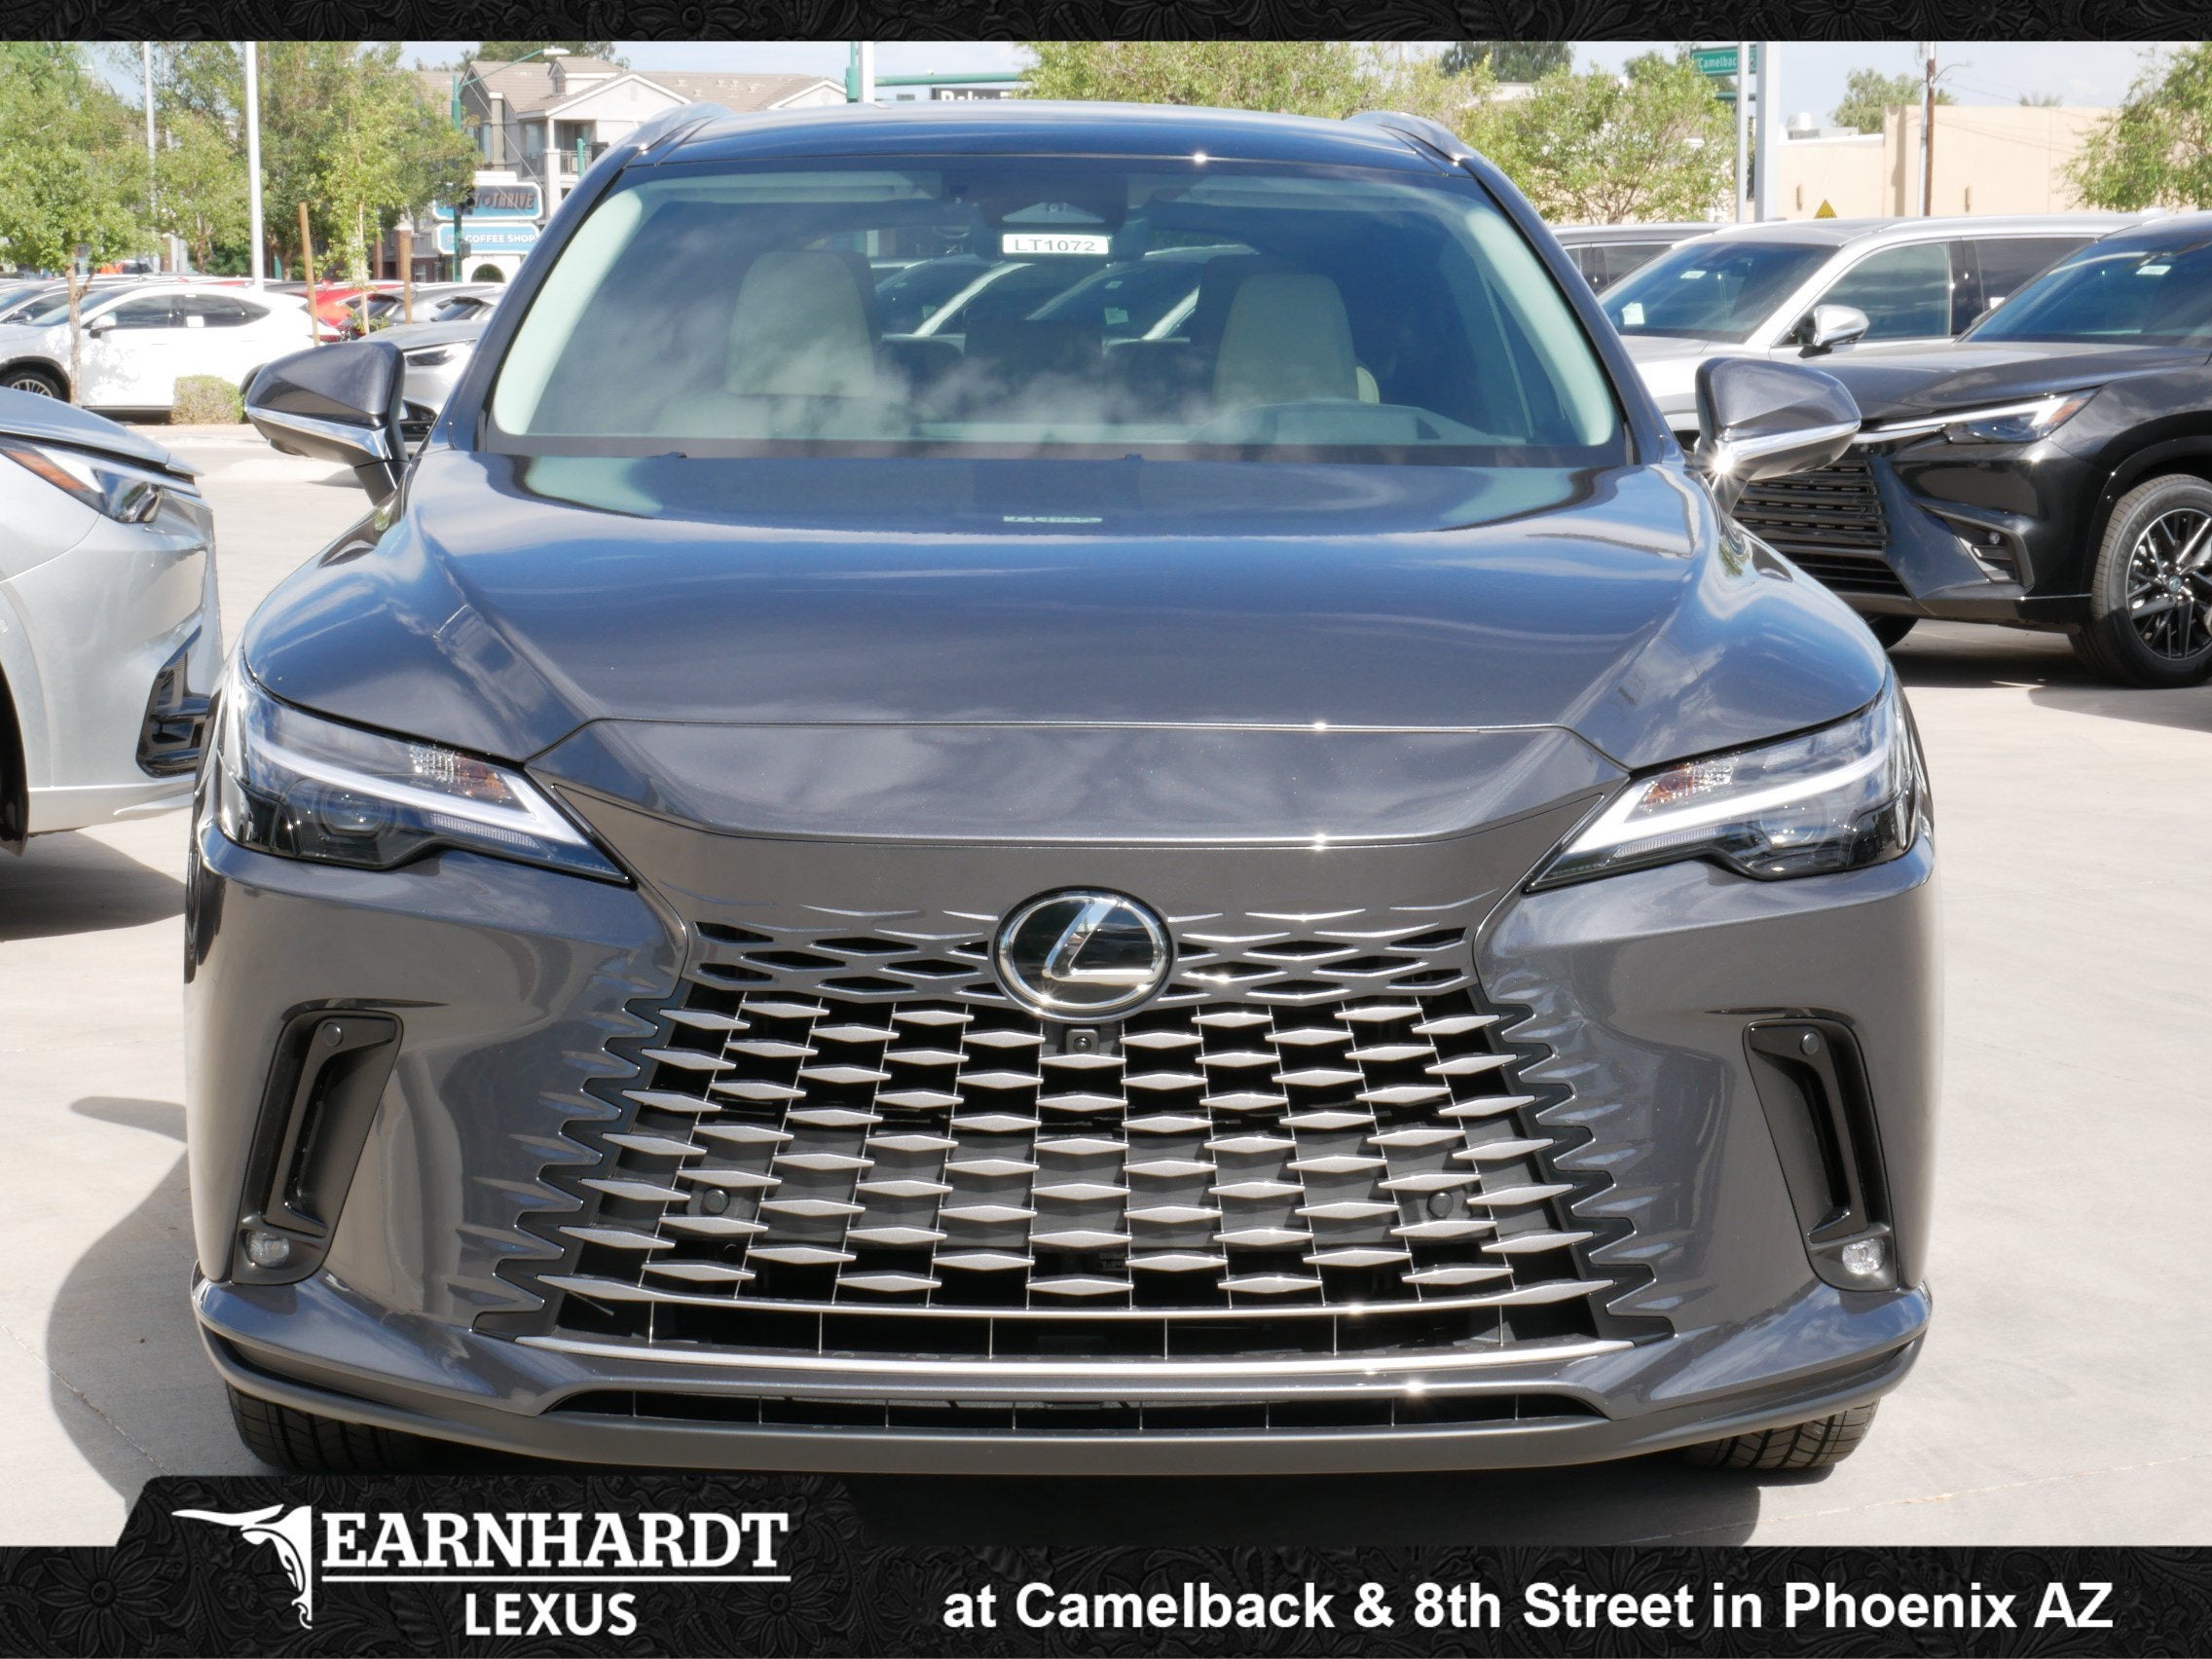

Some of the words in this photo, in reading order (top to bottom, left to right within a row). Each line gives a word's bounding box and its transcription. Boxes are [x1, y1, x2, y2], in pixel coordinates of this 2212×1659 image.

[1698, 55, 1738, 69] Camelbac
[494, 192, 535, 209] THRIVE
[465, 234, 505, 243] COFFEE
[506, 234, 536, 243] SHOP
[1014, 239, 1096, 252] LT1072
